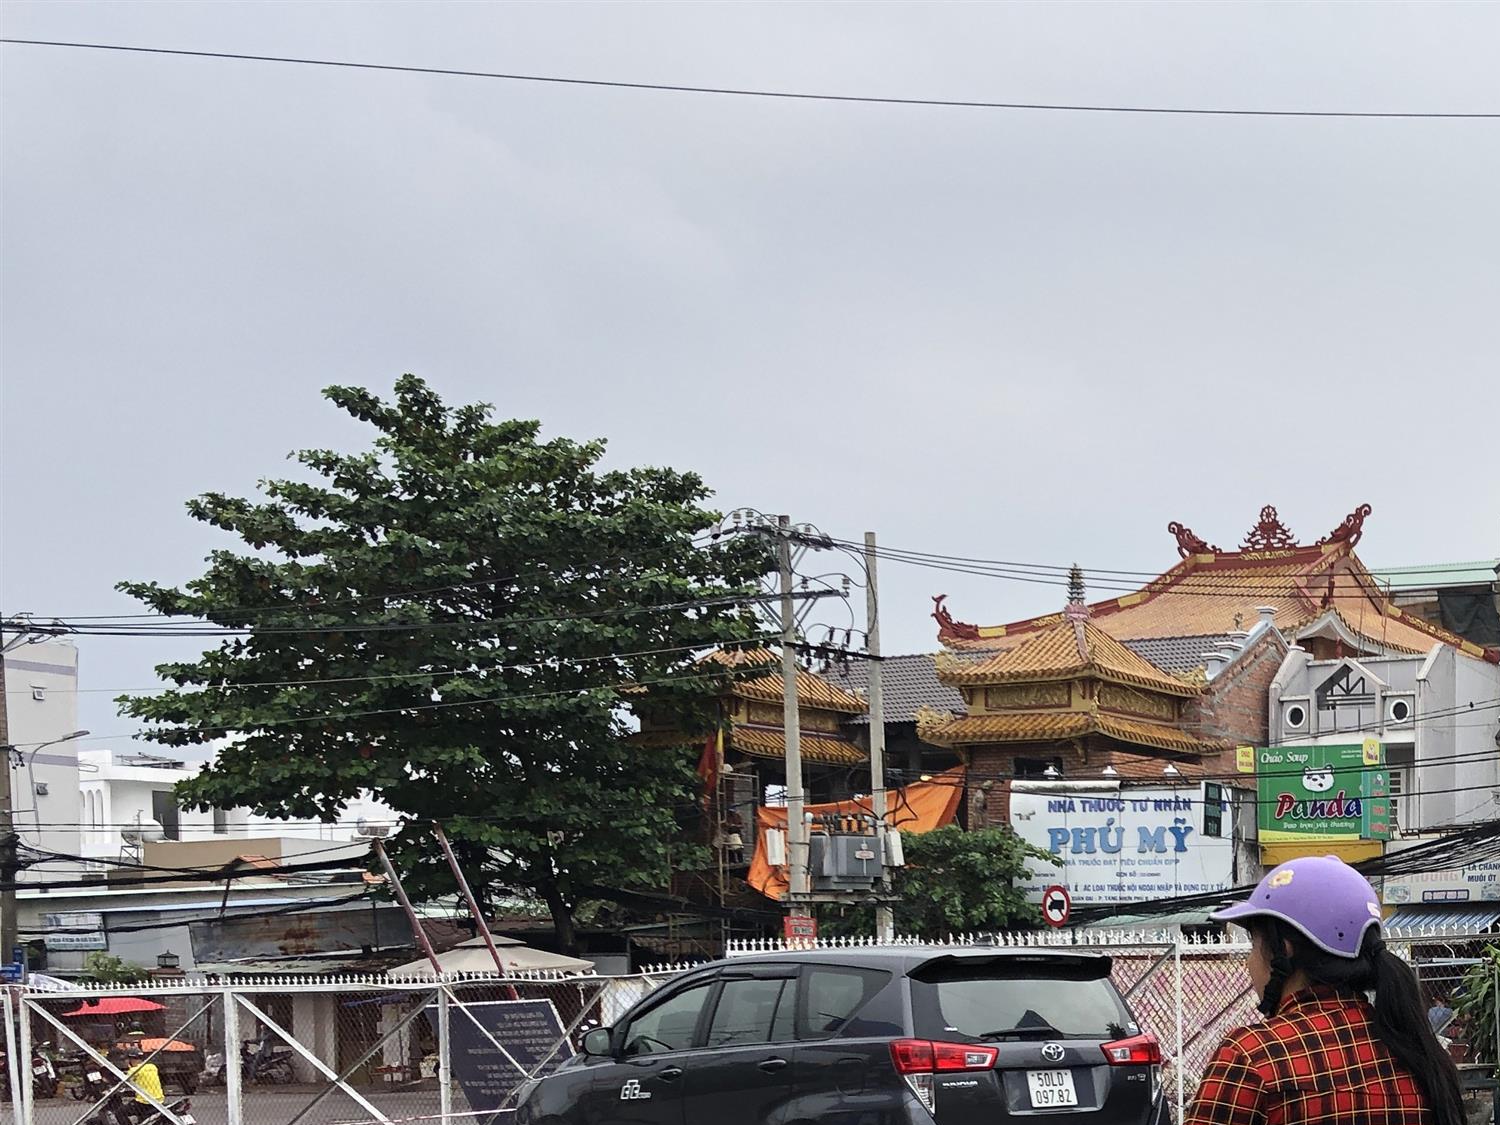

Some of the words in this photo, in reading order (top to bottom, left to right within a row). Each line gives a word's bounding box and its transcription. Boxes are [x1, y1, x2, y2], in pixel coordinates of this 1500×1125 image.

[1286, 751, 1309, 764] Soup
[1275, 790, 1363, 820] Panda
[1048, 818, 1125, 854] PHÚ
[1137, 818, 1194, 853] MỸ
[1037, 1072, 1065, 1087] 50LD
[1036, 1089, 1073, 1104] 097.82
